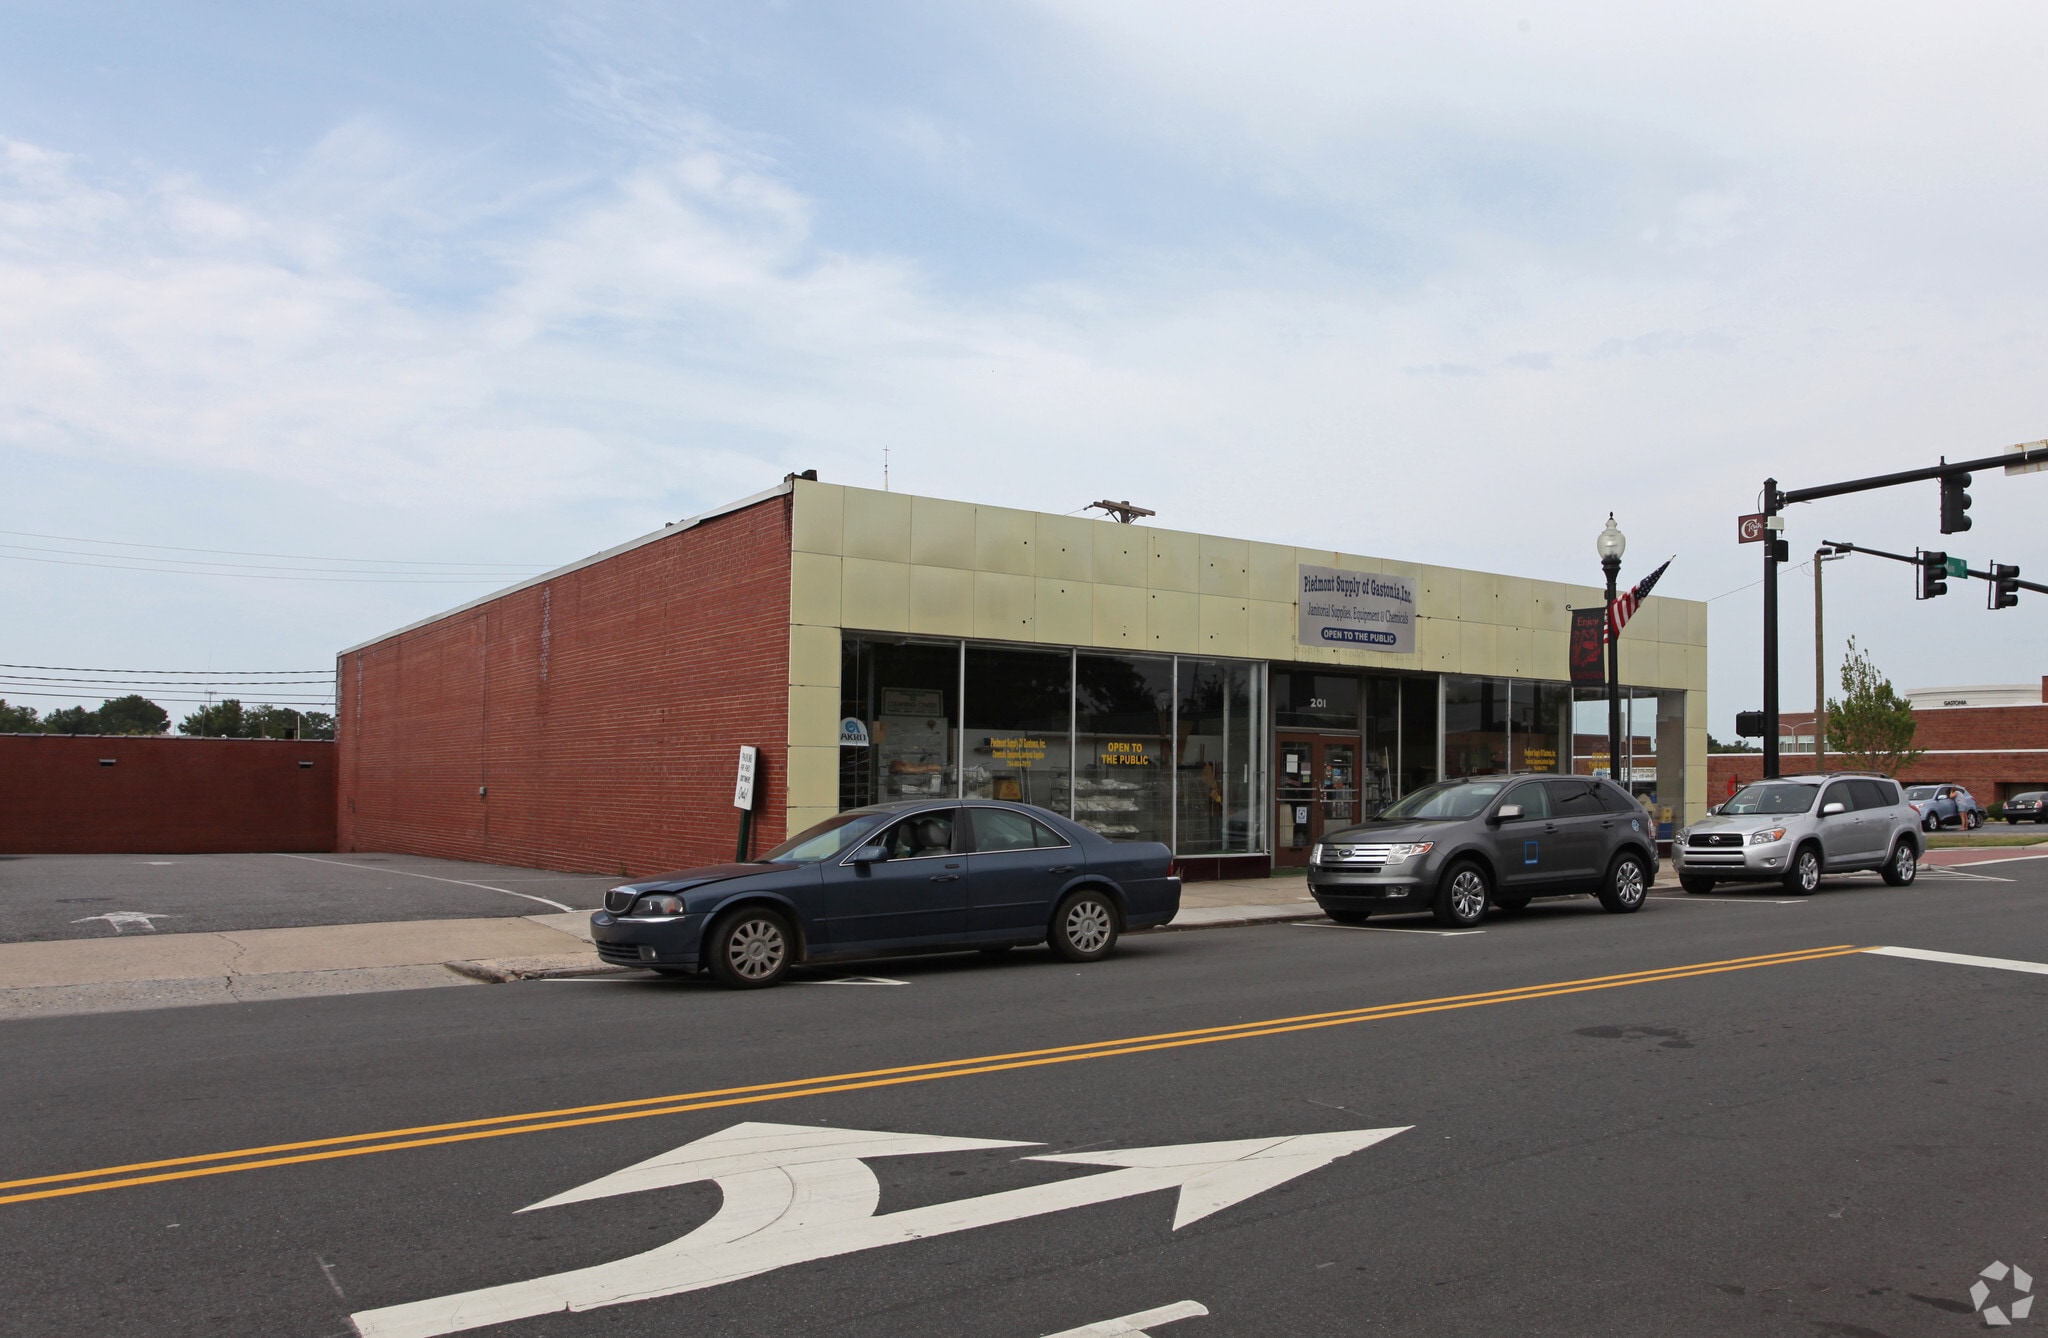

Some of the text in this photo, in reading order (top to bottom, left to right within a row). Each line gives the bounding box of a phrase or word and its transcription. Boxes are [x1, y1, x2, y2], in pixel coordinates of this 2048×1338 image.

[1304, 575, 1335, 593] Piedmont
[1336, 575, 1360, 598] Supply
[1362, 578, 1370, 595] of
[1307, 602, 1331, 617] Janitorial
[1353, 606, 1380, 624] Equipment
[1386, 609, 1409, 625] Chemicals
[1577, 616, 1600, 627] Enjoy
[1323, 629, 1394, 643] OPEN TO THE PUBLIC
[1310, 698, 1327, 708] 201
[1107, 742, 1143, 753] OPEN TO
[1101, 754, 1149, 765] THE PUBLIC
